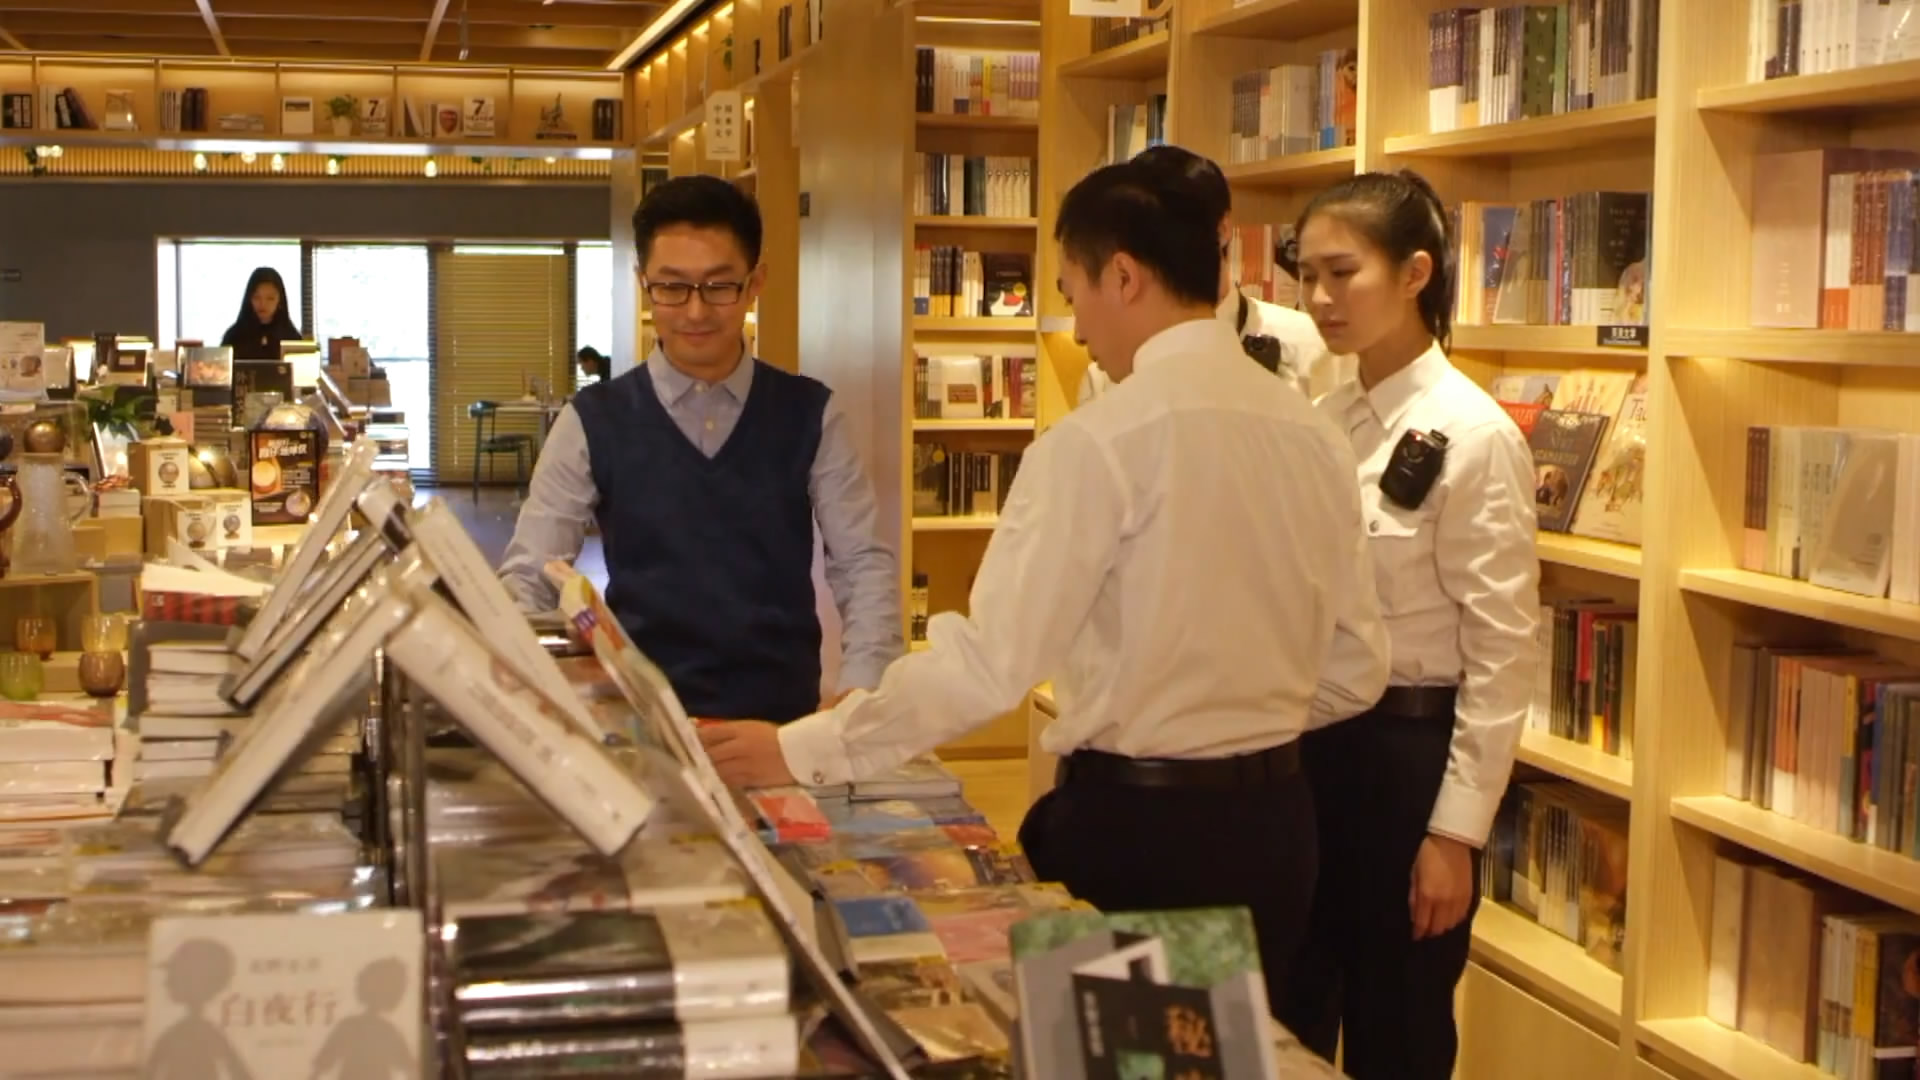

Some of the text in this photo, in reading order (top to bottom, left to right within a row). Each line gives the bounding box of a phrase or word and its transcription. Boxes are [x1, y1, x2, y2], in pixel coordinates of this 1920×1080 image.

[368, 100, 380, 116] 7
[472, 100, 485, 116] 7
[222, 990, 338, 1026] 白夜行
